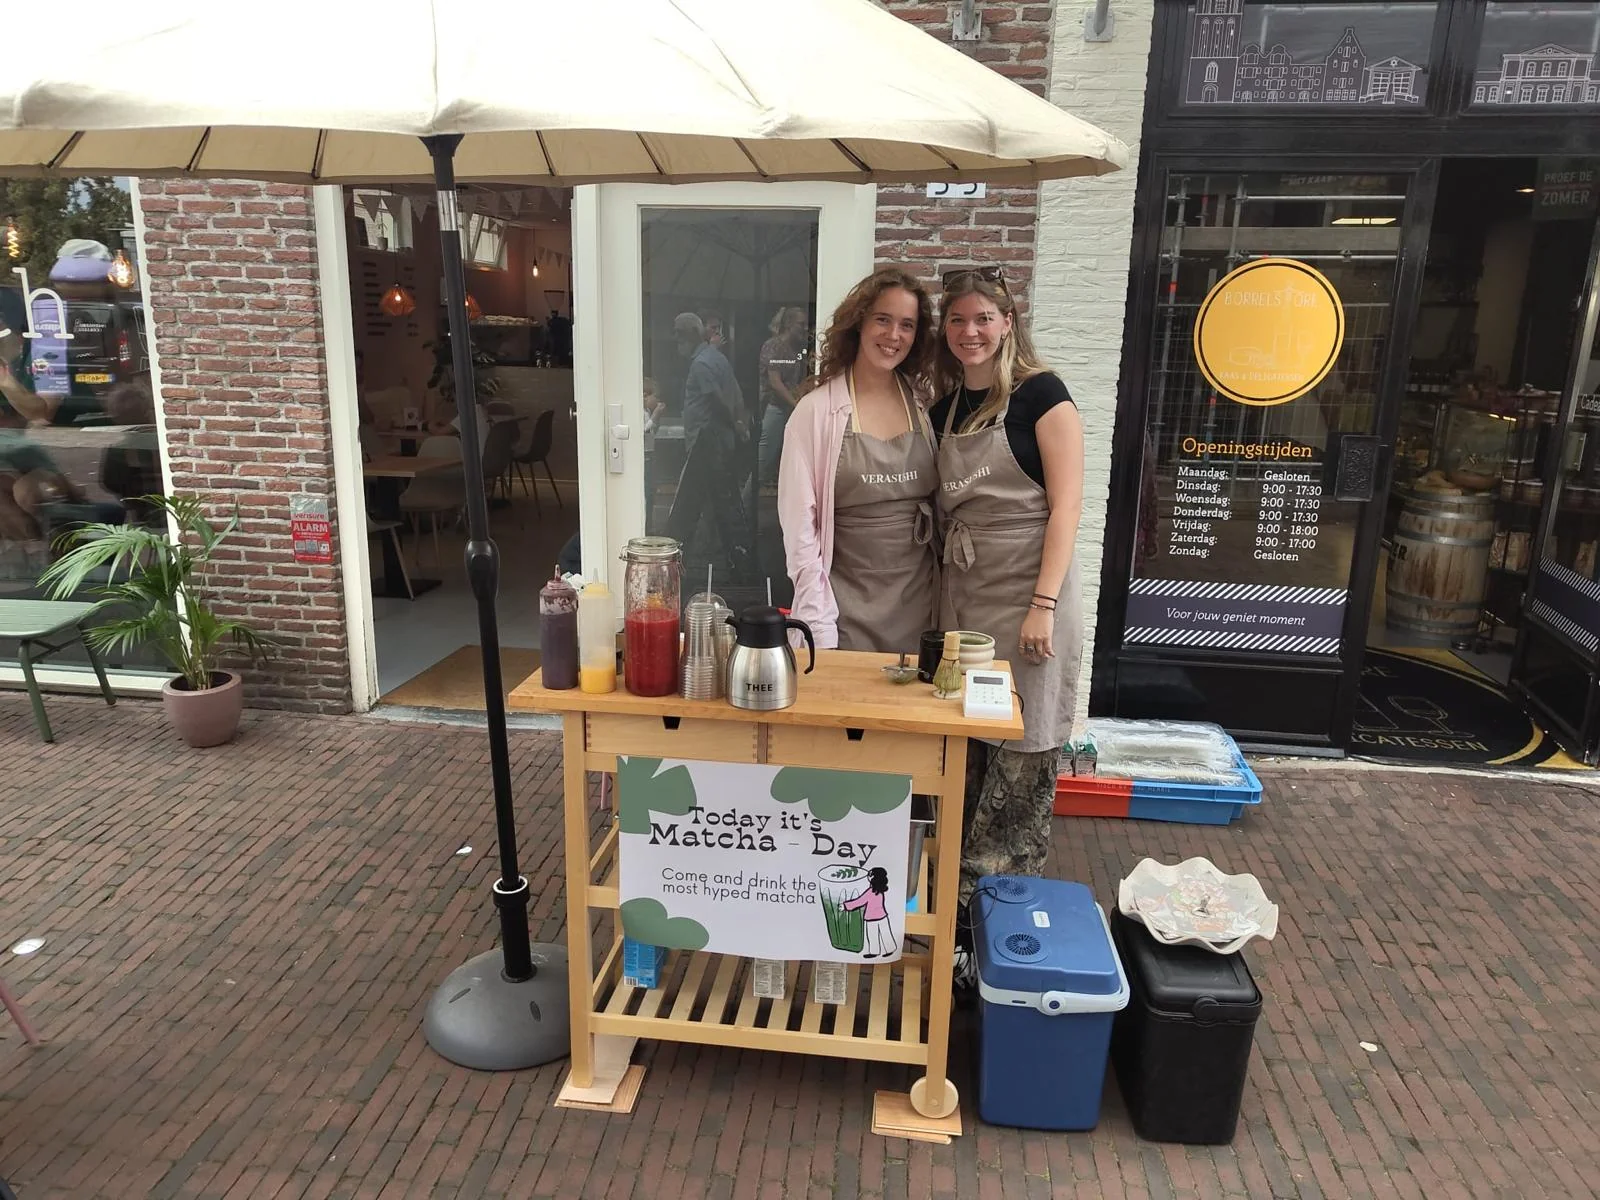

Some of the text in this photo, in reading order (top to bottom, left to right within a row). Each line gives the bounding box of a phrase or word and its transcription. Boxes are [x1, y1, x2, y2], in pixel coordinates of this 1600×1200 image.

[1579, 169, 1594, 182] DE
[1541, 190, 1591, 206] ZOMER
[1182, 437, 1313, 460] Openingstijden
[1177, 466, 1311, 482] Maandag: Gesloten
[1176, 480, 1221, 493] Dinsdag:
[1262, 484, 1286, 495] 9:00
[1295, 485, 1322, 496] 17:30
[1175, 493, 1231, 507] Woensdag:
[1260, 497, 1284, 508] 9:00
[1294, 498, 1320, 509] 17:30
[1173, 506, 1232, 520] Donderdag:
[1258, 510, 1282, 521] 9:00
[1292, 512, 1318, 523] 17:30
[293, 522, 328, 533] ALARM
[1172, 519, 1212, 532] Vrijdag:
[1257, 524, 1280, 534] 9:00
[1290, 525, 1319, 536] 18:00
[1170, 532, 1218, 545] Zaterdag:
[1255, 536, 1279, 547] 9:00
[1288, 538, 1316, 549] 17:00
[1169, 545, 1299, 562] Zondag: Gesloten
[1166, 607, 1306, 626] Voor jouw geniet moment
[745, 682, 773, 692] THEE
[688, 806, 822, 834] Today it's
[648, 822, 778, 853] Matcha
[811, 832, 878, 868] Day
[661, 867, 817, 891] Come and drink the
[662, 881, 816, 904] most hyped matcha
